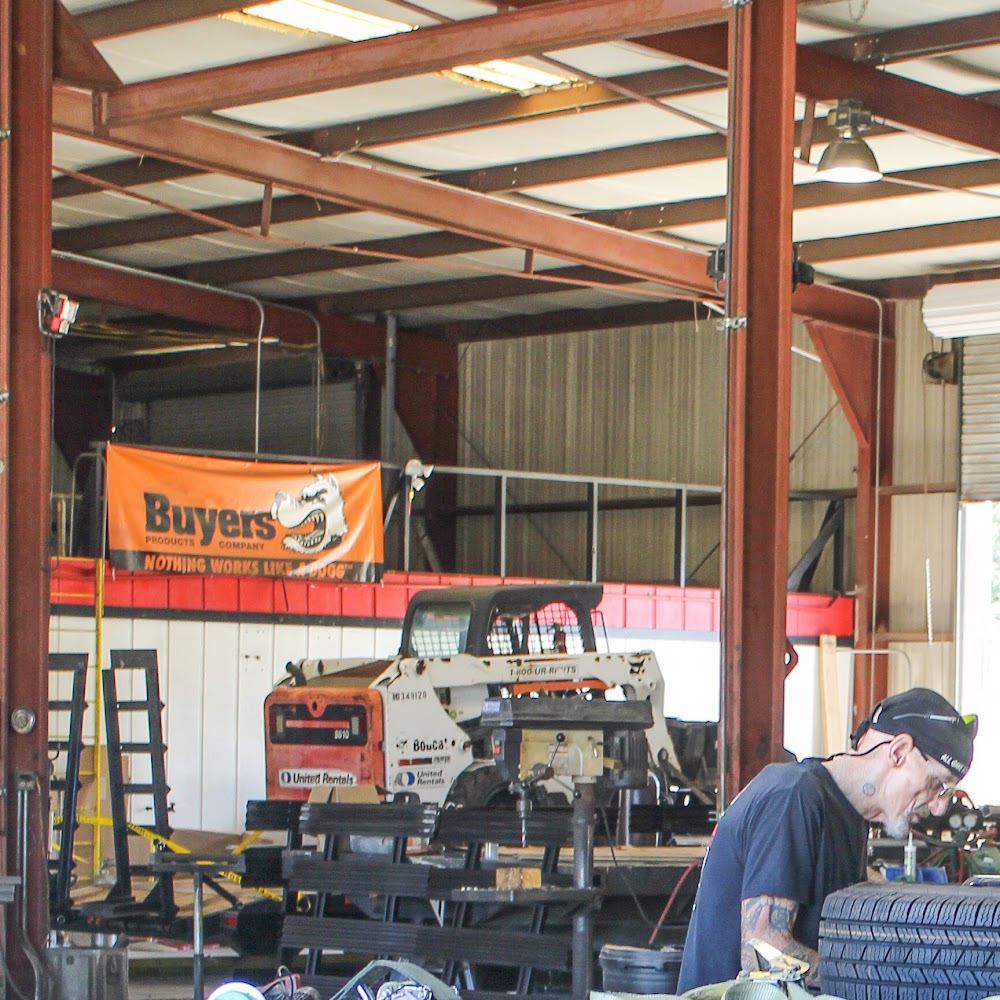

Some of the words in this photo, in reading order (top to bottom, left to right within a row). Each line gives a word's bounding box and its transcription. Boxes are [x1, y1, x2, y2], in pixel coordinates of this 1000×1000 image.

[143, 491, 277, 547] Buyers
[145, 535, 195, 547] PRODUCTS
[218, 540, 265, 551] COMPANY
[144, 553, 206, 574] NOTHING
[210, 558, 259, 576] WORKS
[263, 560, 294, 577] LIKE
[293, 772, 321, 784] United
[322, 772, 354, 785] Rentals
[417, 769, 443, 778] United
[416, 777, 445, 786] Rentals
